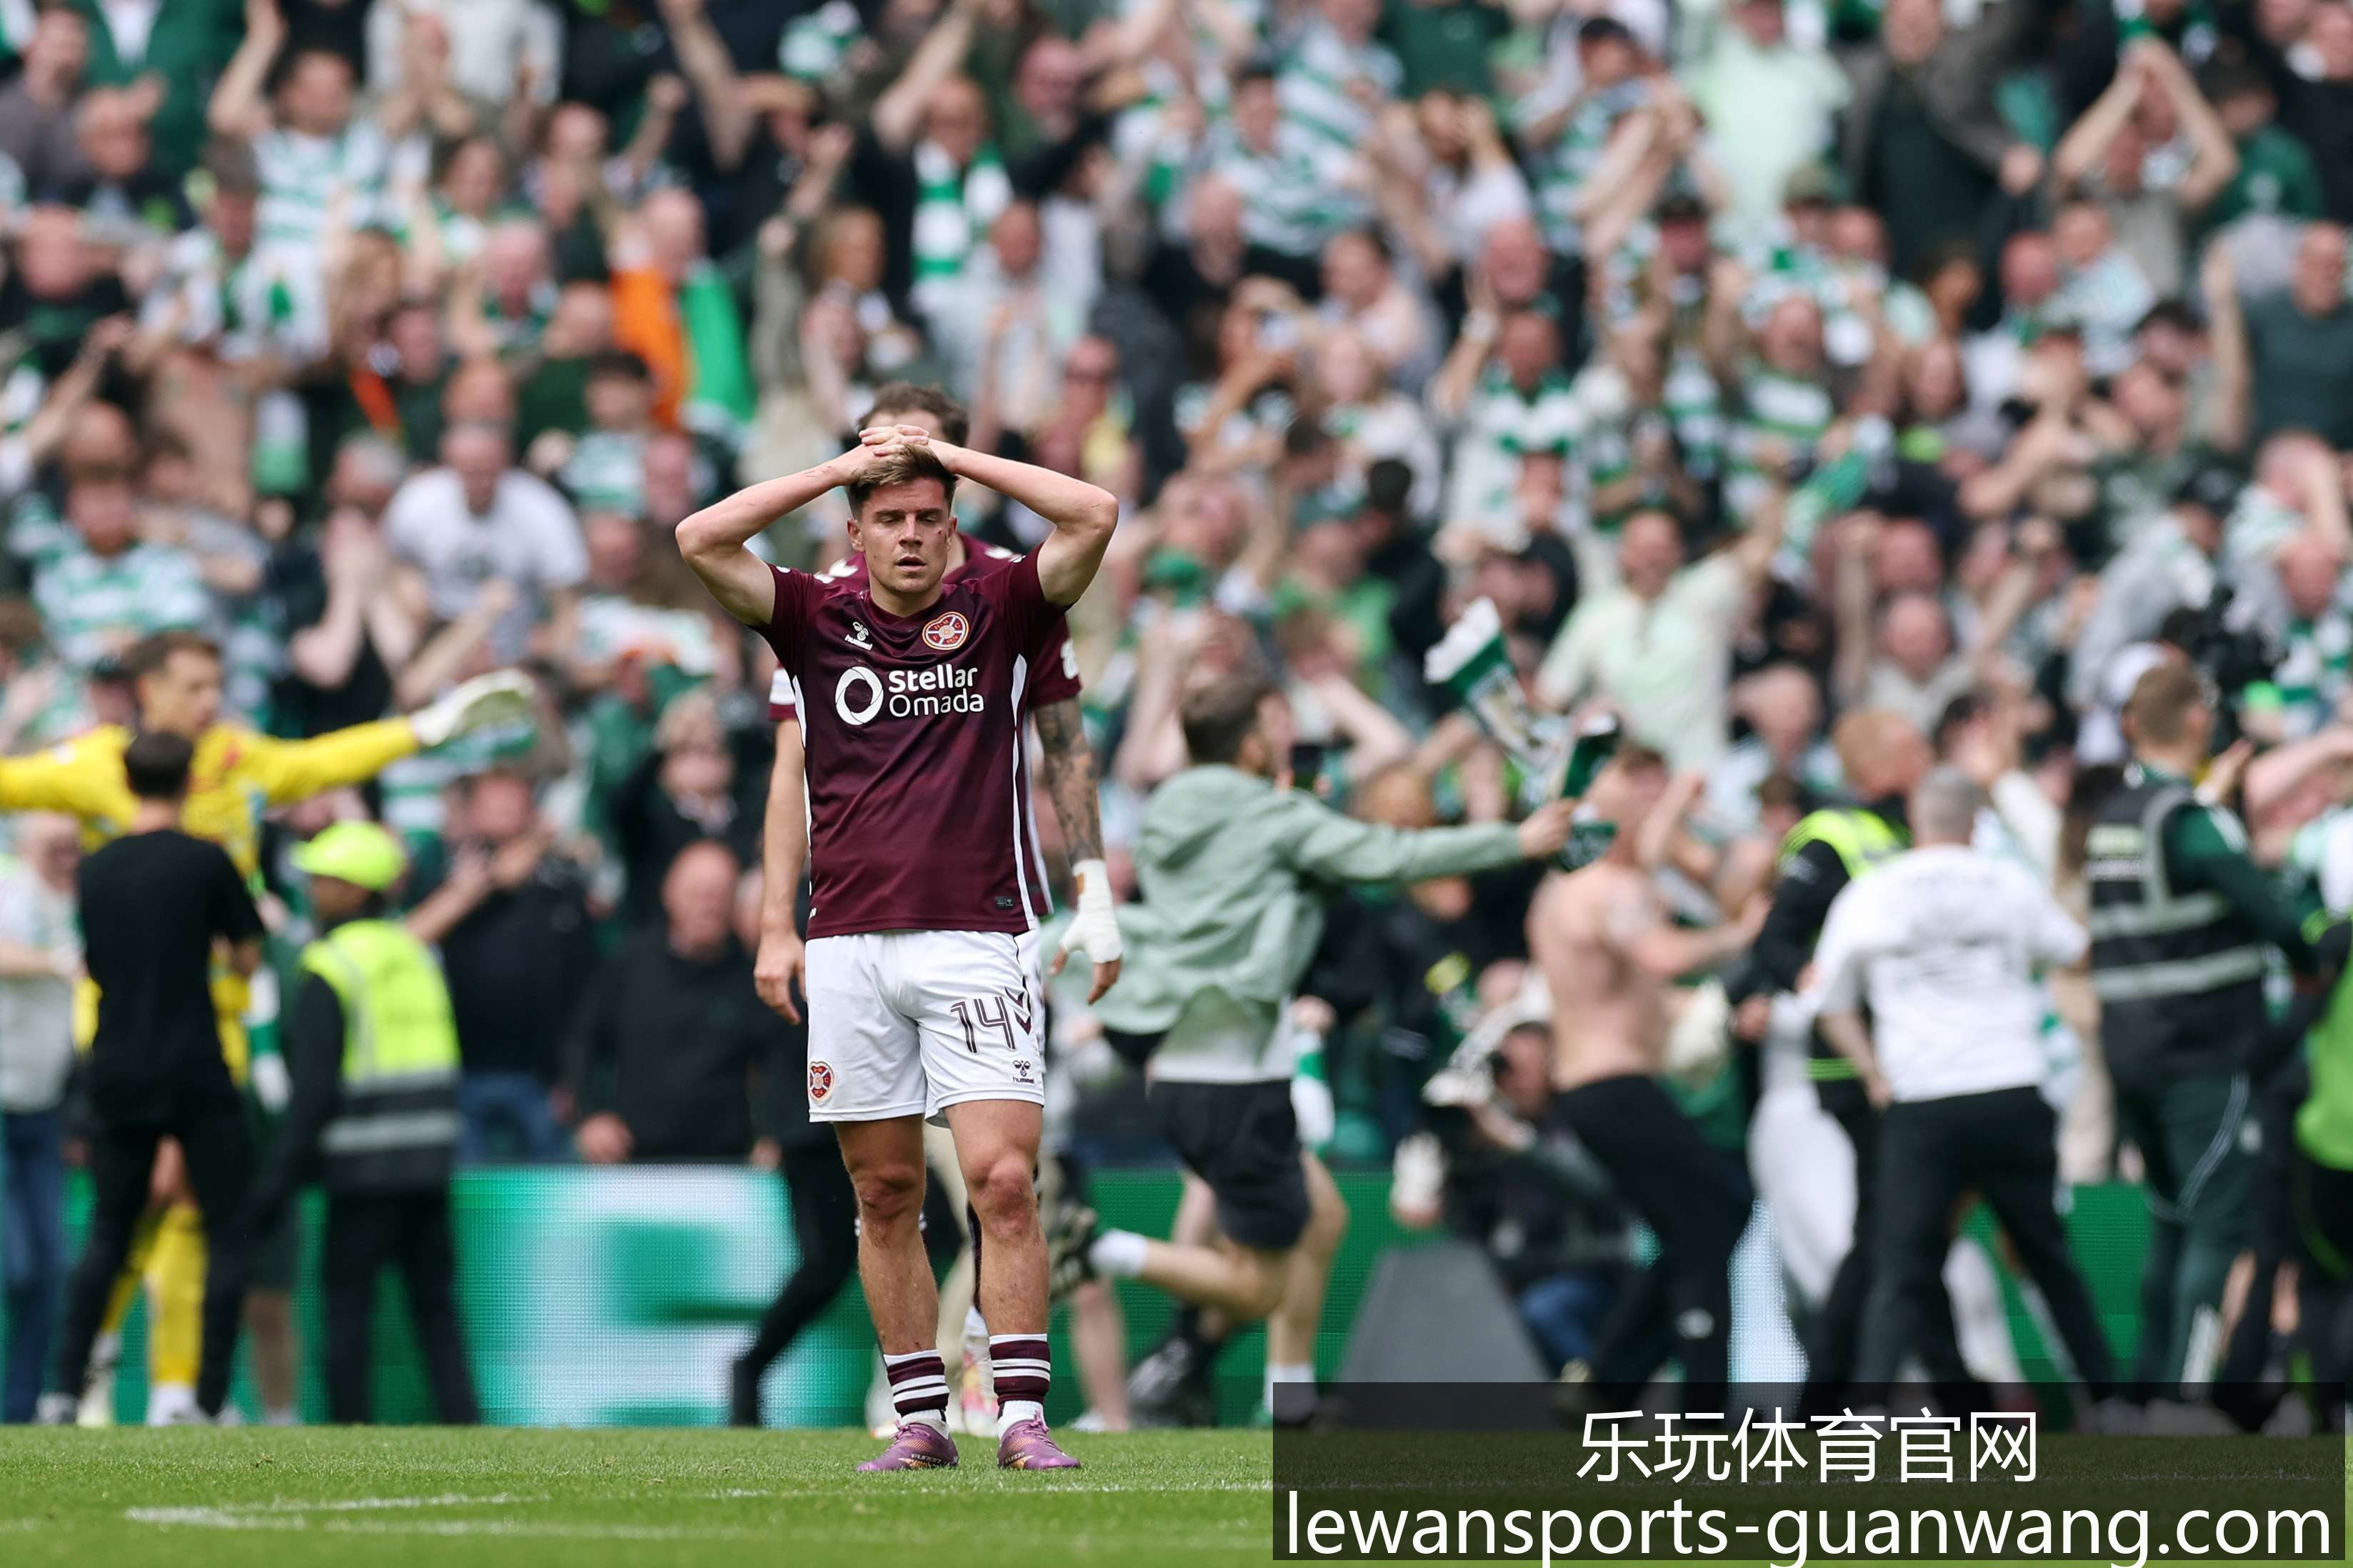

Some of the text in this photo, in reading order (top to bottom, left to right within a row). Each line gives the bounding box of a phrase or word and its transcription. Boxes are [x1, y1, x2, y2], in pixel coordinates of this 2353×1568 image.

[889, 664, 978, 693] Stellar
[889, 688, 984, 717] Omada
[949, 996, 1016, 1054] 14
